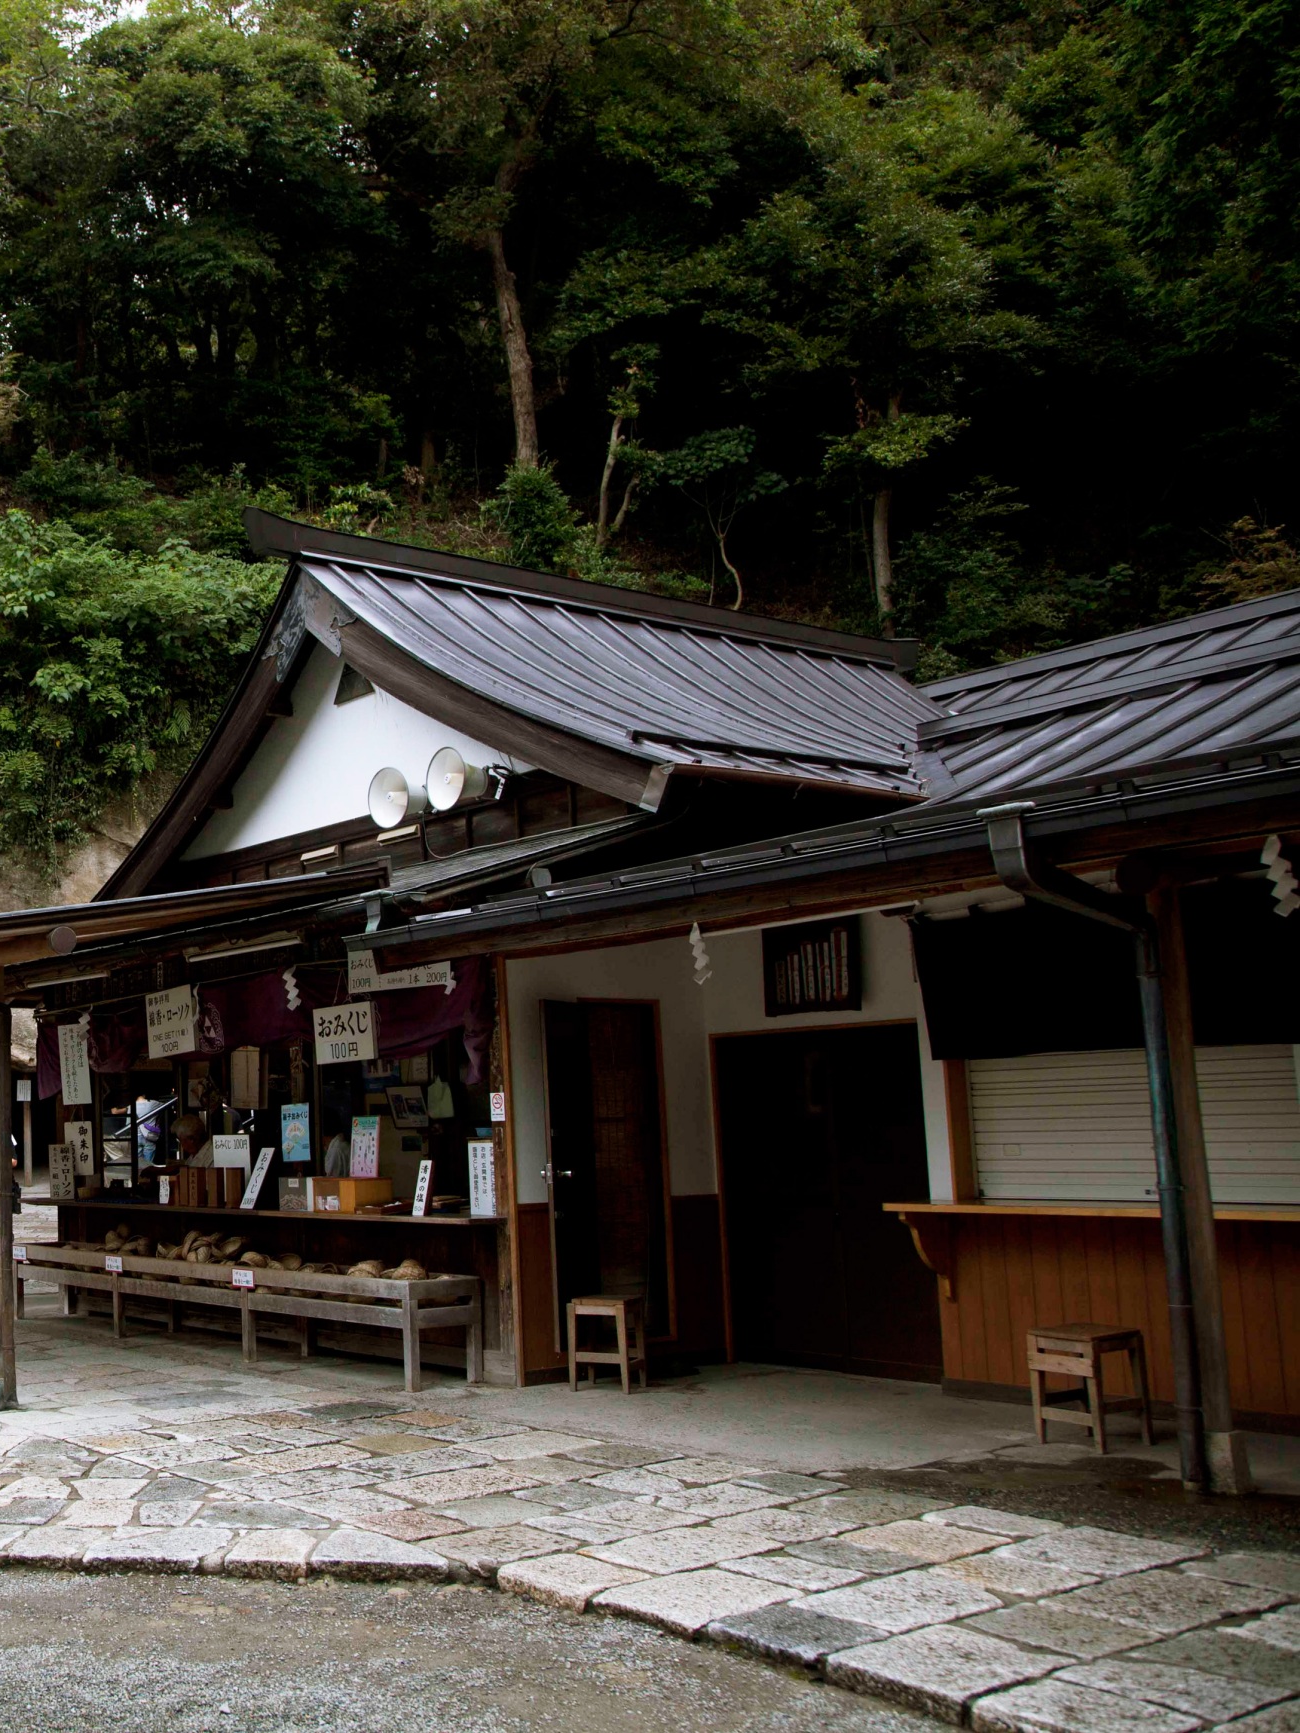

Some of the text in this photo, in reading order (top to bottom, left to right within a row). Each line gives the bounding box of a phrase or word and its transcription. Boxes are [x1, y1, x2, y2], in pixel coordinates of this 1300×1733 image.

[352, 977, 371, 989] 100円
[426, 971, 448, 983] 200円
[149, 1002, 190, 1027] 線香・ローソク
[318, 1010, 368, 1038] おみくじ
[152, 1033, 163, 1042] ONE
[161, 1041, 179, 1053] 100円
[330, 1042, 358, 1059] 100円
[78, 1126, 89, 1164] 御朱印
[214, 1138, 232, 1150] おみくじ
[250, 1152, 269, 1194] おみくじ
[416, 1164, 429, 1203] 清めの塩
